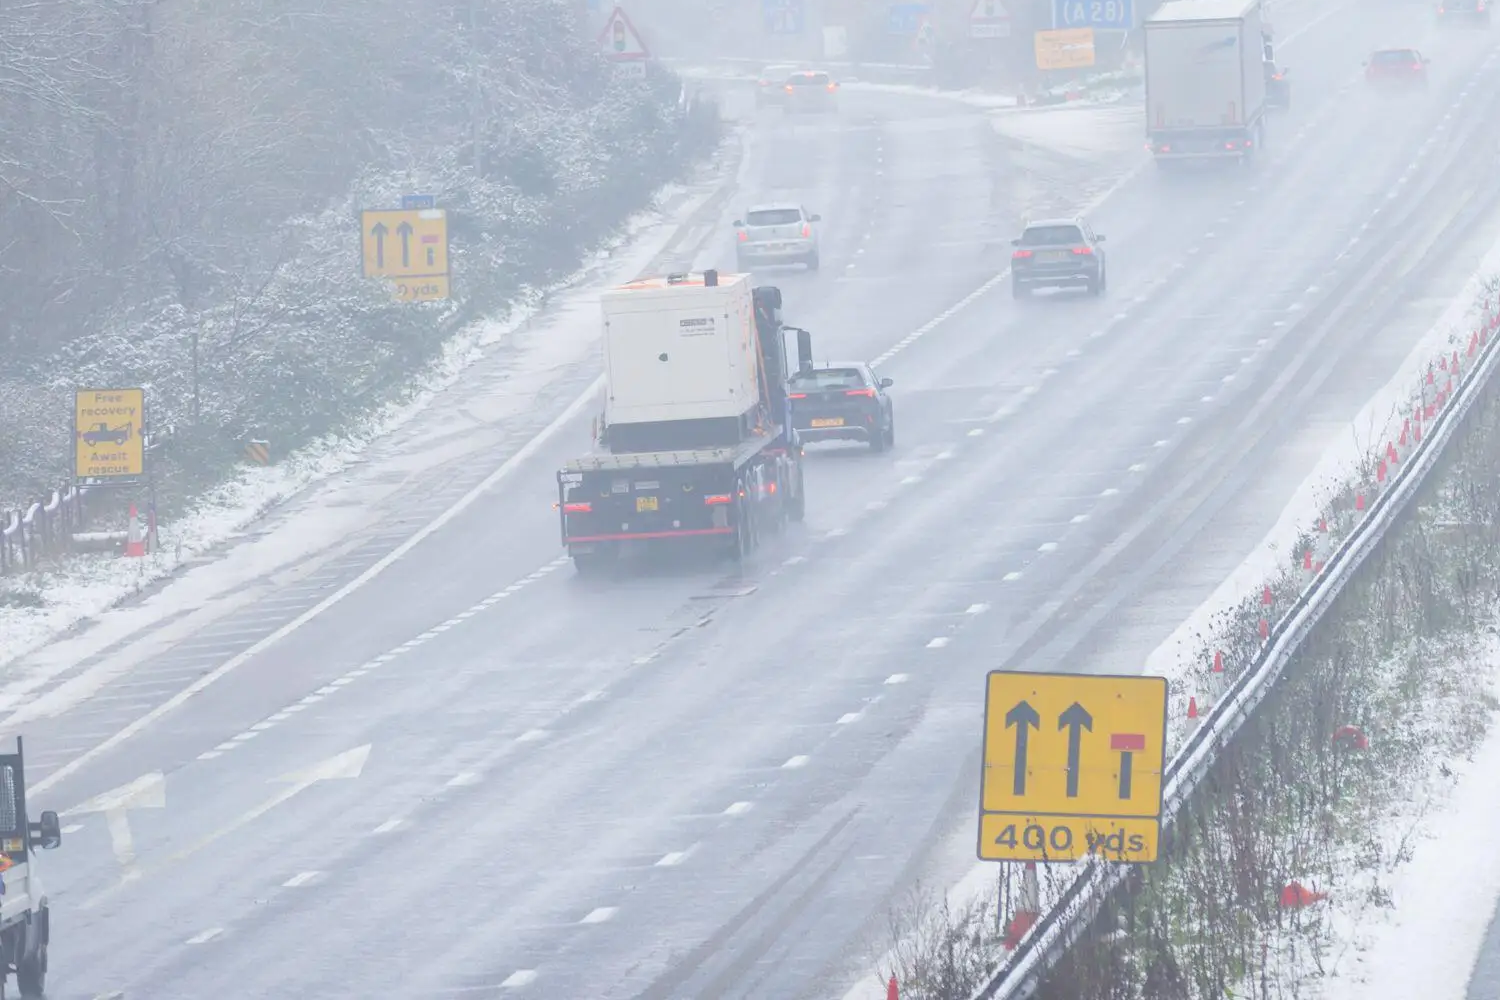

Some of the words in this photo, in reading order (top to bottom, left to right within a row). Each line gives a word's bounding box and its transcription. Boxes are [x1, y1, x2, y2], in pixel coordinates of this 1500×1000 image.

[412, 283, 439, 297] yds
[94, 393, 122, 403] Free
[81, 406, 136, 417] recovery
[90, 452, 128, 461] Await
[88, 465, 129, 474] rescue
[994, 824, 1073, 851] 400
